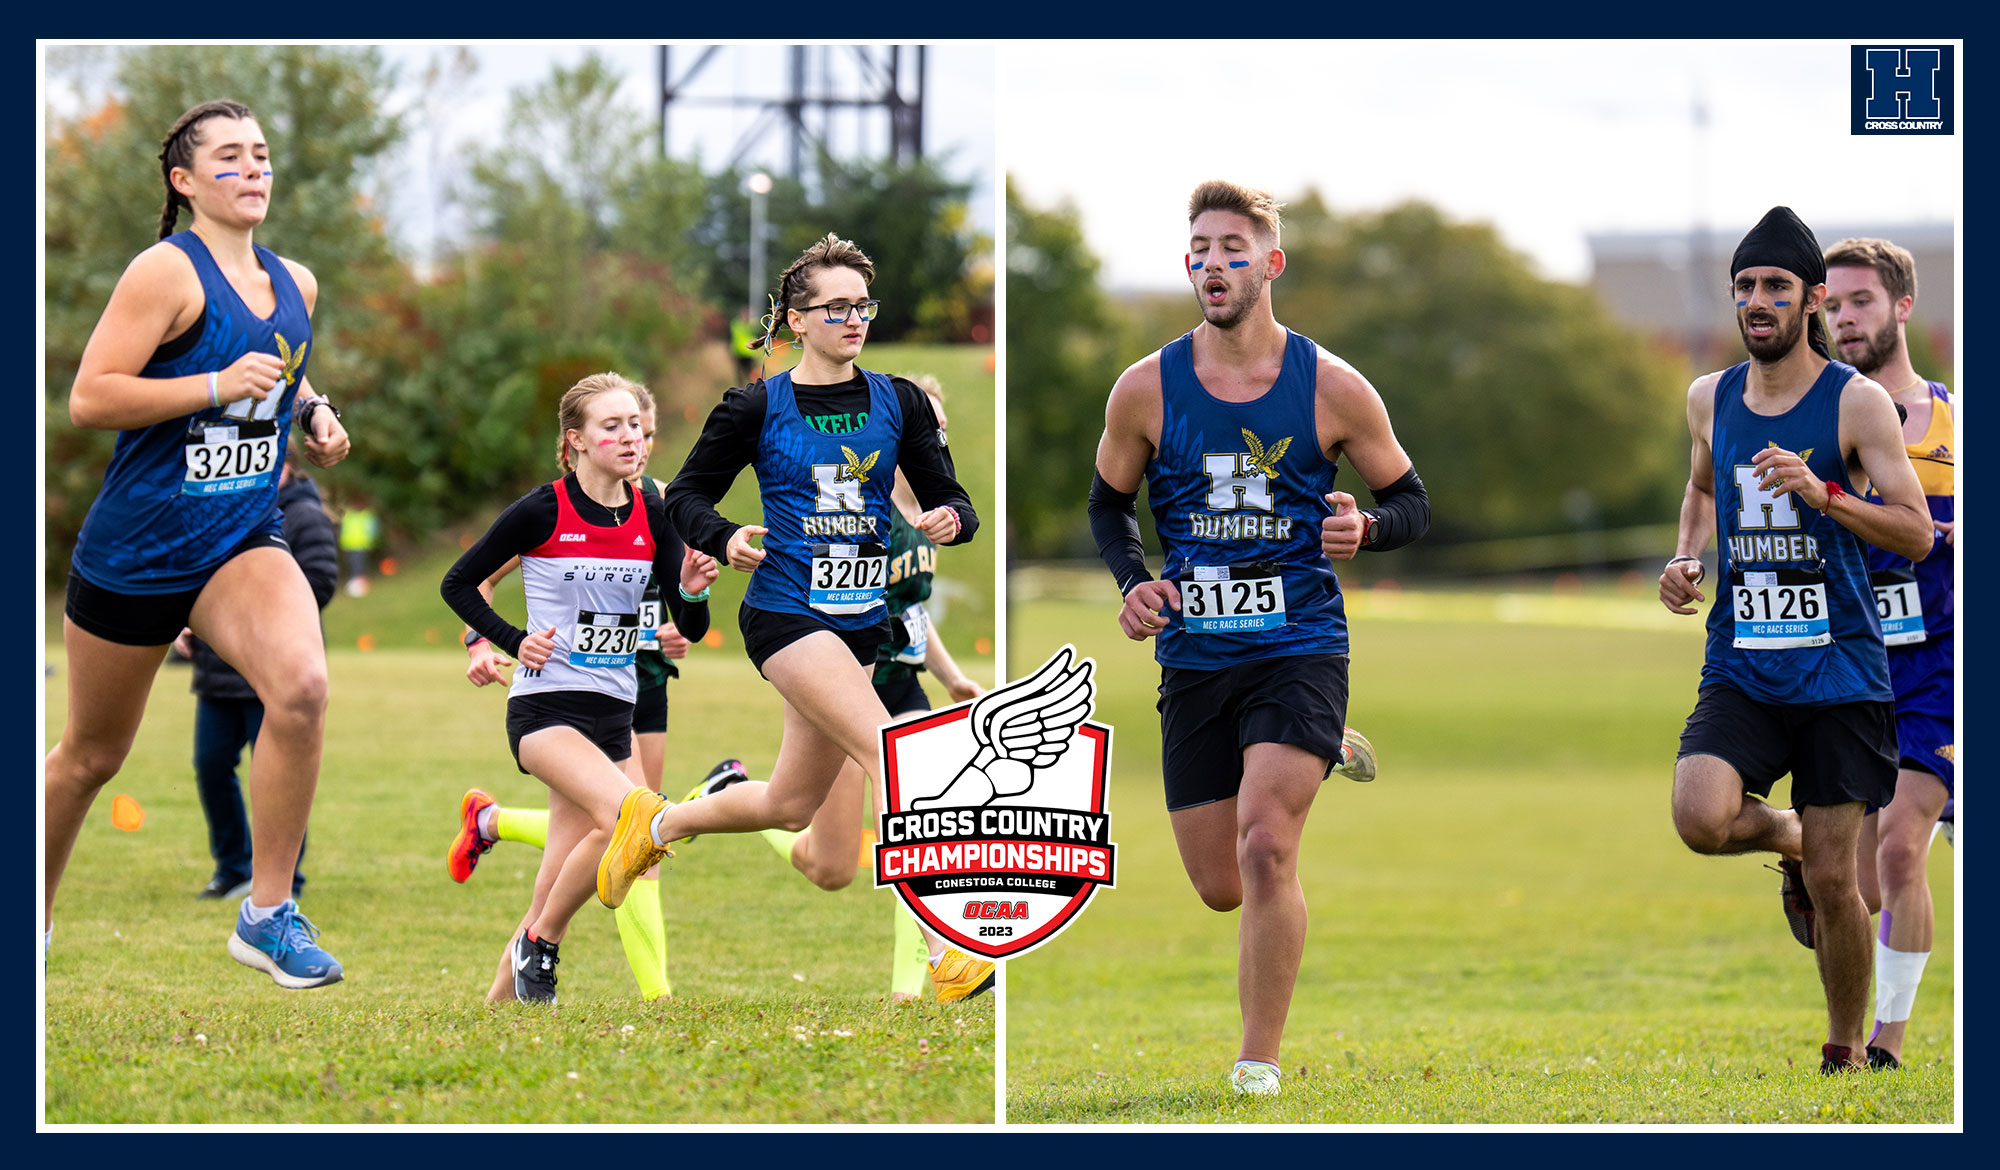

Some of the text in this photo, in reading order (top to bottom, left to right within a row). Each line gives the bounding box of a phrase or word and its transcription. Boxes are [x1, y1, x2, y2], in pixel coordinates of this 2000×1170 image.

[194, 441, 270, 480] 3203
[812, 464, 865, 512] H
[1203, 452, 1274, 513] H
[1734, 464, 1800, 530] H
[559, 533, 587, 542] OCAA
[801, 514, 877, 536] HUMBER
[1189, 512, 1293, 540] HUMBER
[1728, 534, 1819, 562] HUMBER
[563, 571, 648, 585] SURGE
[592, 565, 642, 573] LAWRENCE
[817, 558, 882, 589] 3202
[890, 549, 918, 584] ST.
[826, 592, 873, 601] MEC RACE SERIES
[1187, 580, 1277, 616] 3125
[1738, 587, 1819, 620] 3126
[1203, 618, 1265, 630] MEC RACE SERIES
[1752, 624, 1809, 634] MEC RACE SERIES
[578, 627, 638, 653] 3230
[585, 656, 597, 664] MEC
